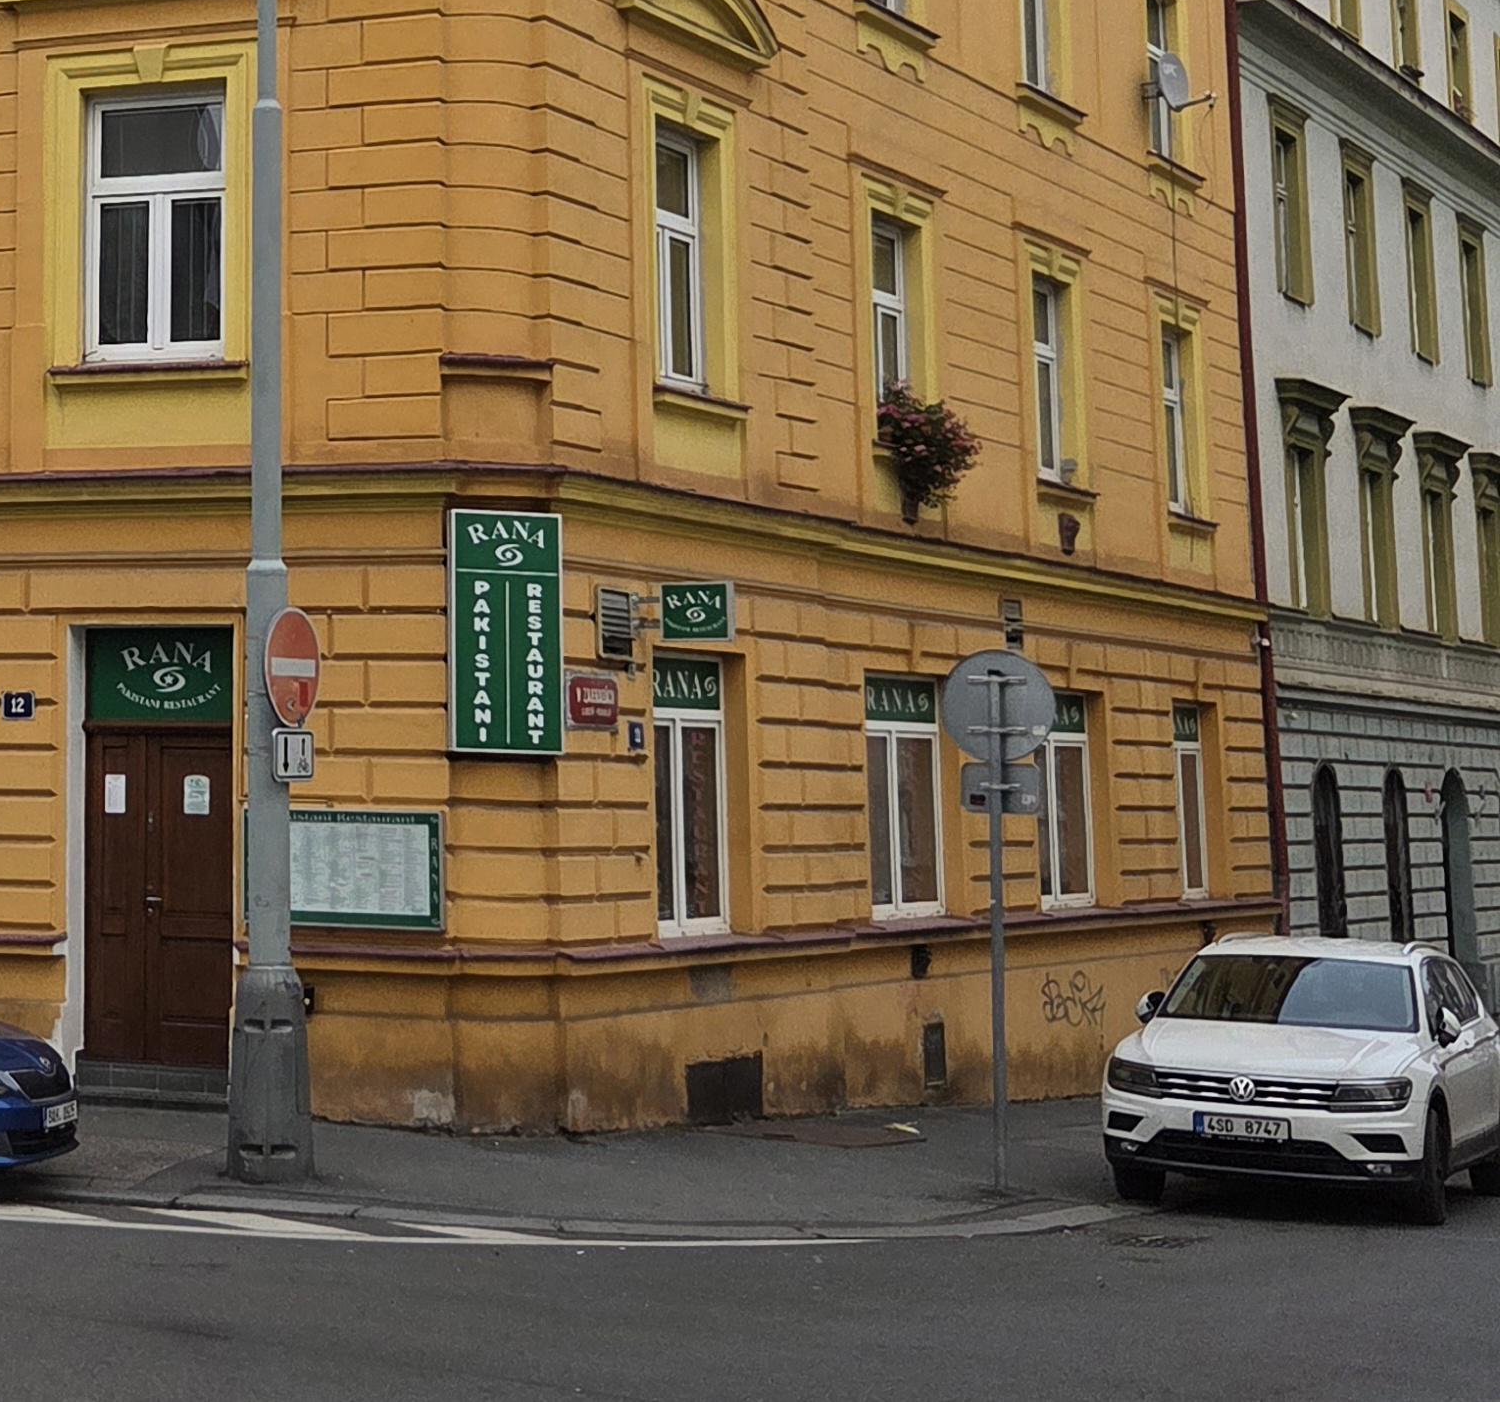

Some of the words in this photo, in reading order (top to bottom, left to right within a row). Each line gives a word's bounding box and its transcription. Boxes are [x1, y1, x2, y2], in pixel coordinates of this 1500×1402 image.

[467, 520, 545, 549] RANA
[665, 590, 721, 610] RANA
[120, 641, 212, 674] RANA
[472, 580, 492, 743] PAKISTANI
[525, 582, 545, 745] RESTAURANT
[11, 697, 25, 713] 12
[116, 682, 161, 709] PAKISTANI
[163, 683, 222, 710] RESTAURANT
[866, 685, 916, 714] RANA
[1208, 1117, 1234, 1133] 4SD
[1244, 1120, 1281, 1136] 8747
